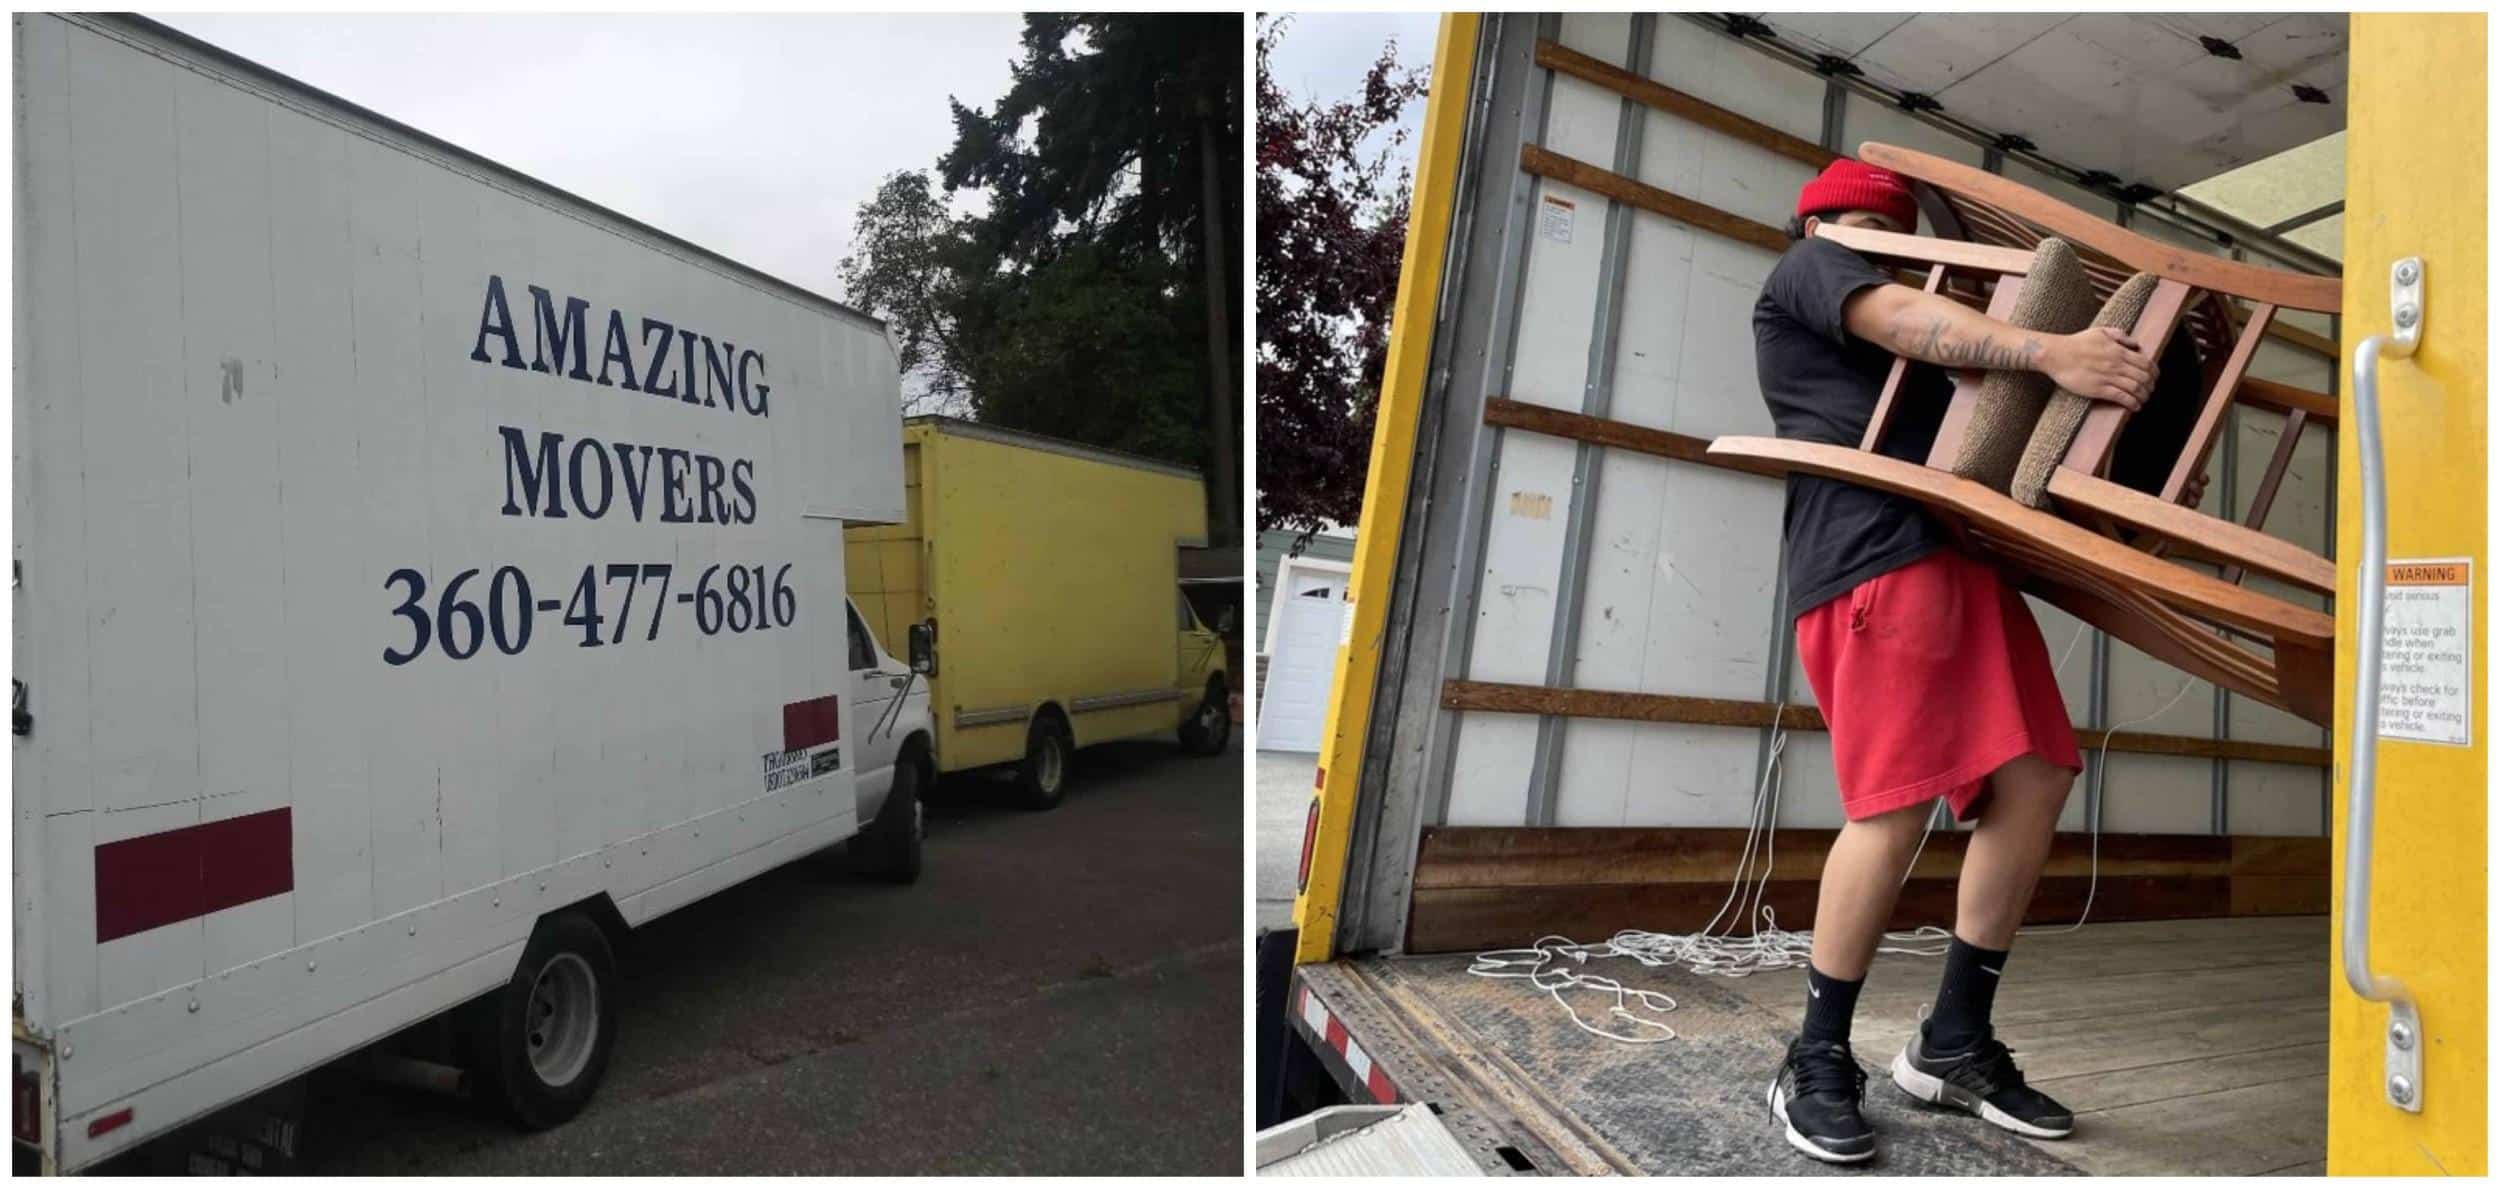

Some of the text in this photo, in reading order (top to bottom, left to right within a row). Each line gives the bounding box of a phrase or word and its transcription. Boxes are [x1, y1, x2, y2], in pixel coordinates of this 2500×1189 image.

[471, 275, 770, 418] AMAZING
[499, 425, 756, 526] MOVERS
[2392, 567, 2456, 582] WARNING
[2405, 591, 2440, 601] serious
[383, 562, 796, 666] 360-477-6816
[2410, 627, 2430, 637] use
[2432, 625, 2457, 639] grab
[2405, 638, 2435, 649] when
[2413, 651, 2424, 661] or
[2427, 650, 2463, 665] exiting
[2409, 682, 2442, 695] check
[2443, 683, 2459, 697] for
[2400, 694, 2436, 708] before
[2412, 710, 2424, 720] or
[2426, 711, 2463, 726] exiting
